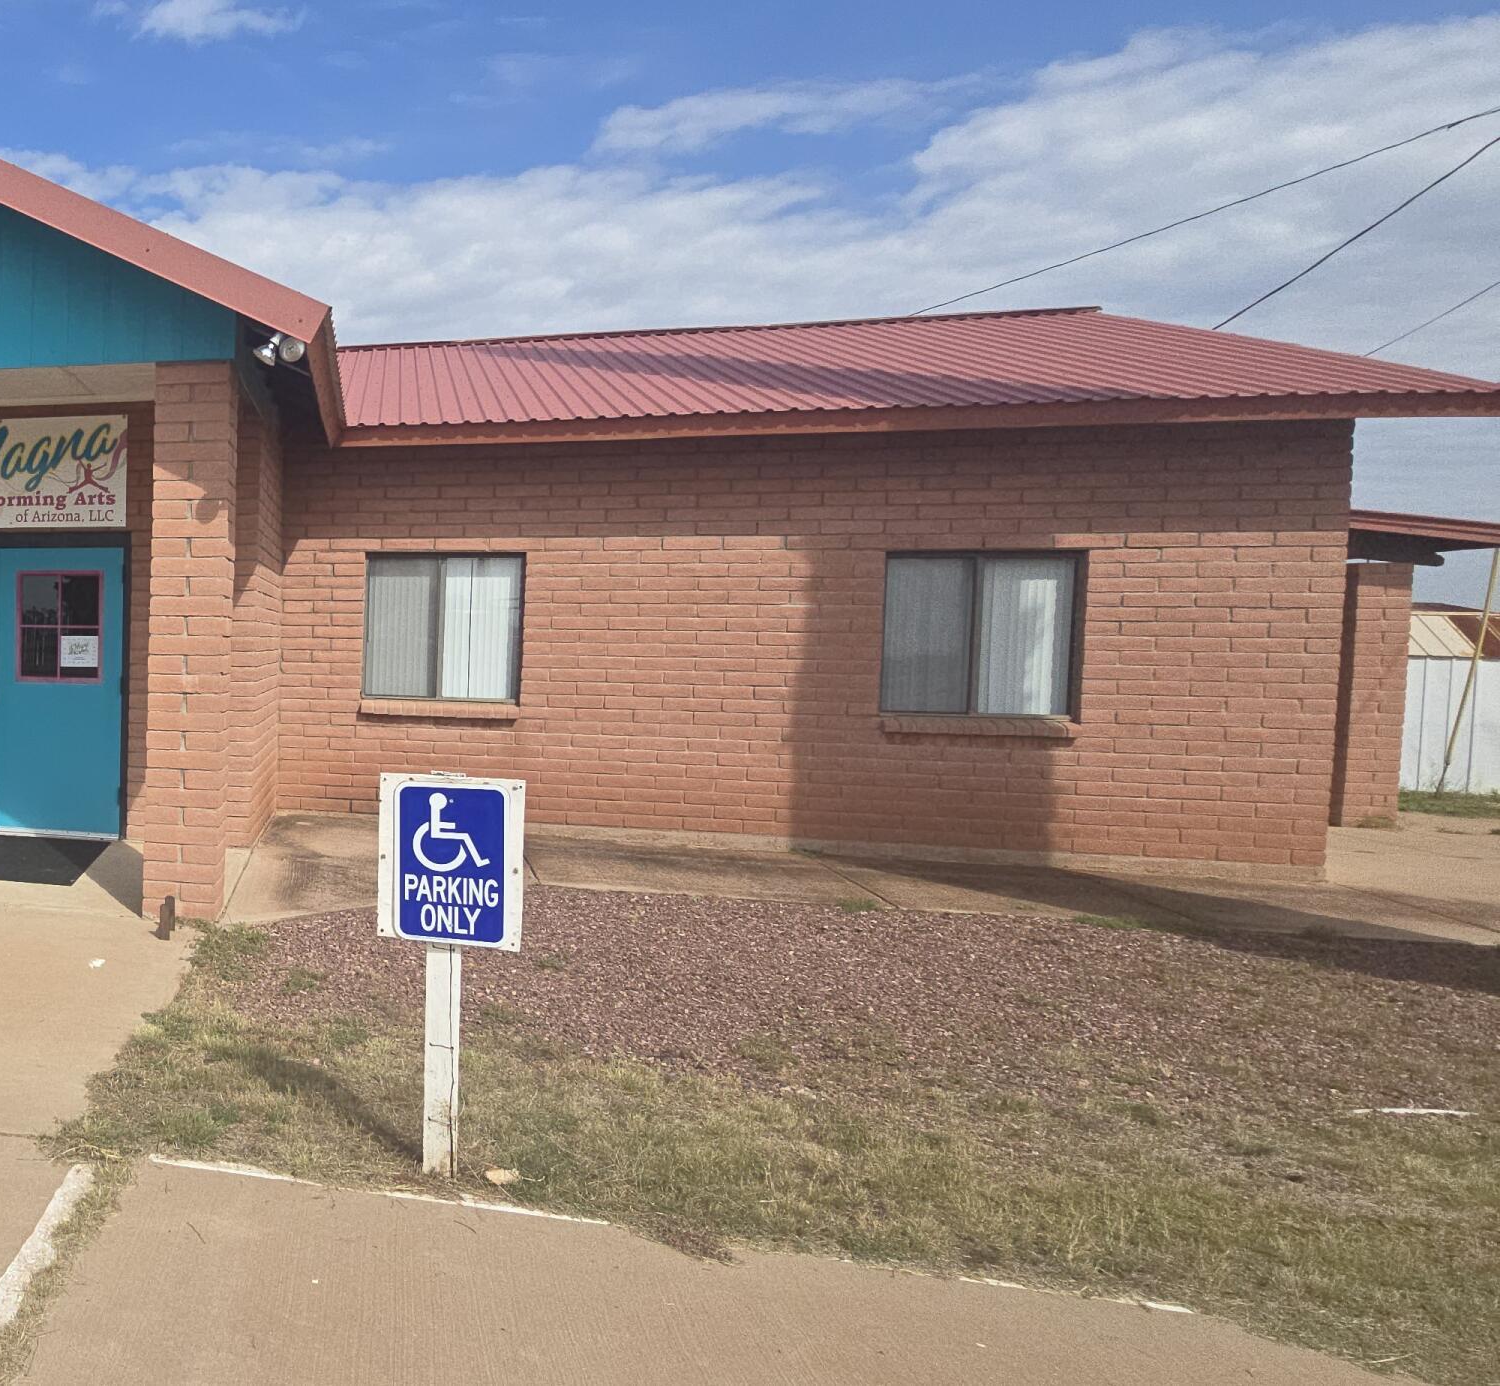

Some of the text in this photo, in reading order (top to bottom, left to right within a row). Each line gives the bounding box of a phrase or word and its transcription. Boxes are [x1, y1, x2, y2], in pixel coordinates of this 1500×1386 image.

[74, 491, 116, 507] Arts
[15, 509, 115, 523] of Arizona, LLC
[404, 873, 499, 908] PARKING
[420, 903, 482, 935] ONLY
